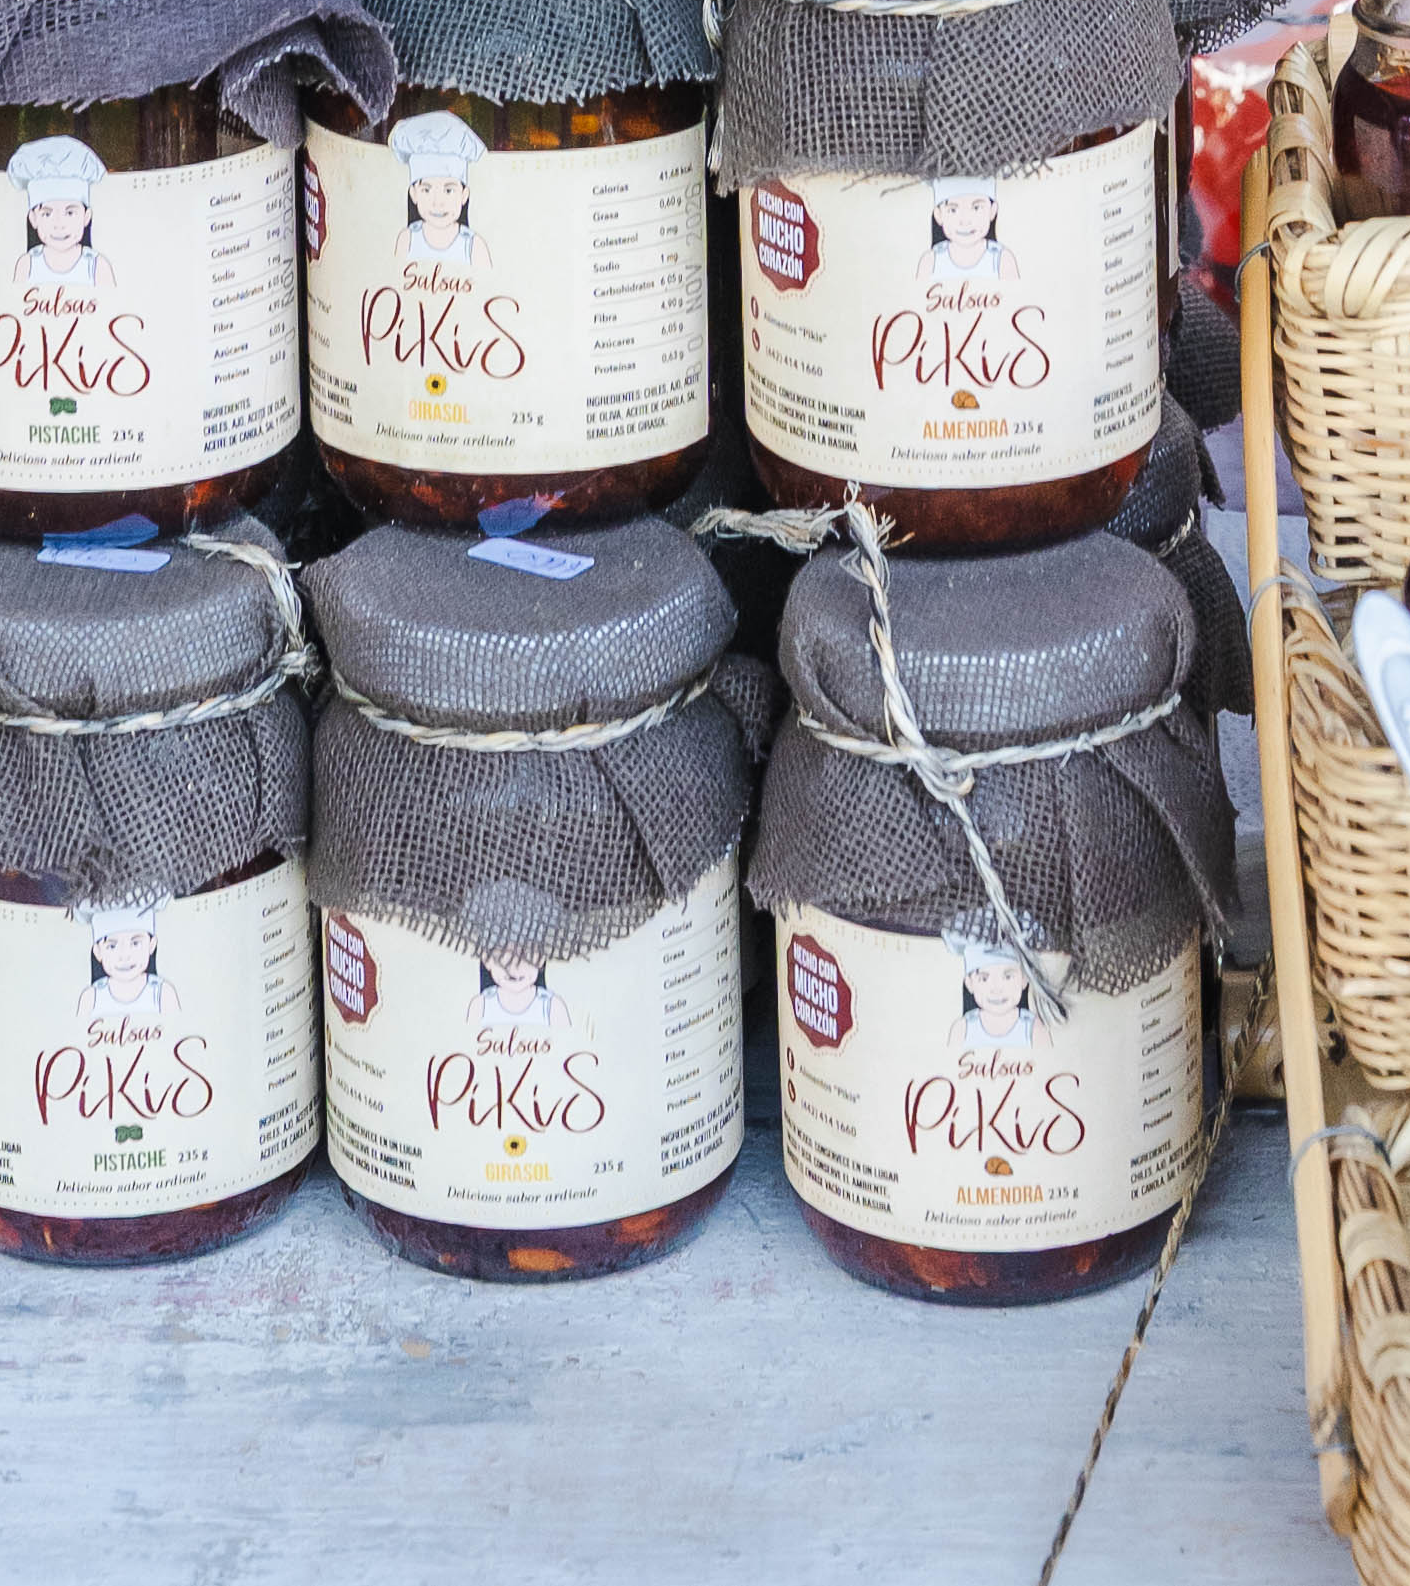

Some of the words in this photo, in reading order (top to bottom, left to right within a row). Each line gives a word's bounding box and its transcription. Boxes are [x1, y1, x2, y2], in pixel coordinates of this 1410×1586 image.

[759, 214, 804, 254] MUCHO
[402, 261, 473, 293] Salsas
[593, 262, 619, 273] Sodio
[22, 286, 98, 316] Salsas
[926, 281, 1001, 314] Salsas
[594, 313, 617, 324] Fibra
[409, 398, 470, 424] GIRASOL
[512, 411, 532, 424] 235
[535, 414, 544, 427] g
[28, 425, 100, 444] PISTACHE
[112, 429, 133, 442] 235
[136, 431, 144, 443] g
[923, 419, 1008, 440] ALMENDRA
[1013, 421, 1035, 435] 235
[1037, 423, 1044, 436] g
[794, 972, 838, 1014] MUCHO
[87, 1015, 162, 1048] Salsas
[476, 1026, 552, 1057] Salsas
[958, 1049, 1034, 1081] Salsas
[94, 1149, 167, 1172] PISTACHE
[178, 1150, 197, 1163] 235
[201, 1150, 208, 1163] g
[485, 1161, 553, 1183] GIRASOL
[594, 1160, 614, 1174] 235
[617, 1161, 624, 1173] g
[956, 1185, 1043, 1205] ALMENDRA
[1049, 1187, 1070, 1200] 235
[1072, 1187, 1079, 1200] g
